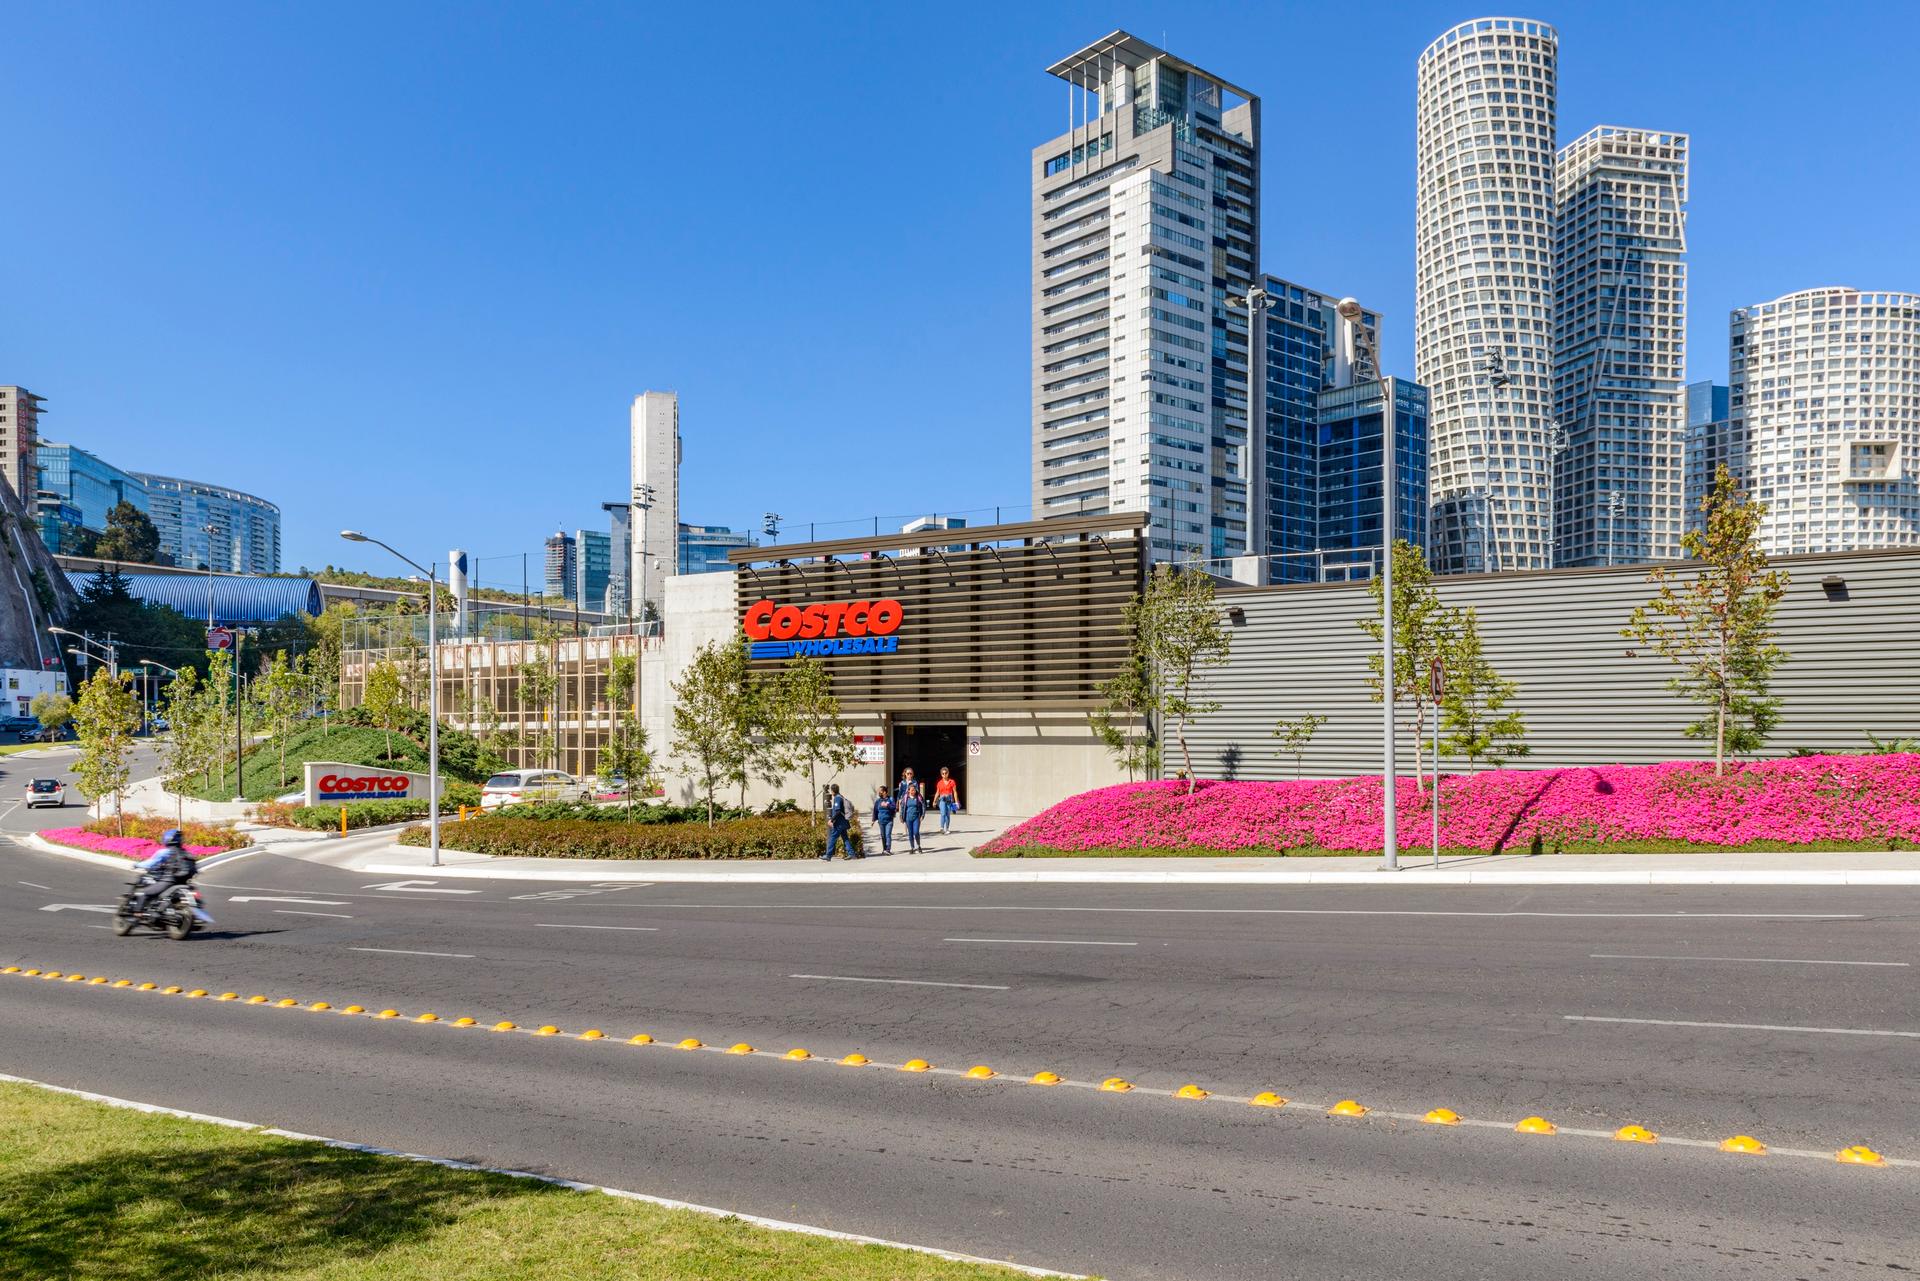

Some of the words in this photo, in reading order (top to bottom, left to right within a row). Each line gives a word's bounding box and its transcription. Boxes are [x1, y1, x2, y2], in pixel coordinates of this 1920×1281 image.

[744, 600, 903, 640] COSTCO
[787, 637, 899, 657] WHOLESALE
[319, 775, 409, 792] COSTCO
